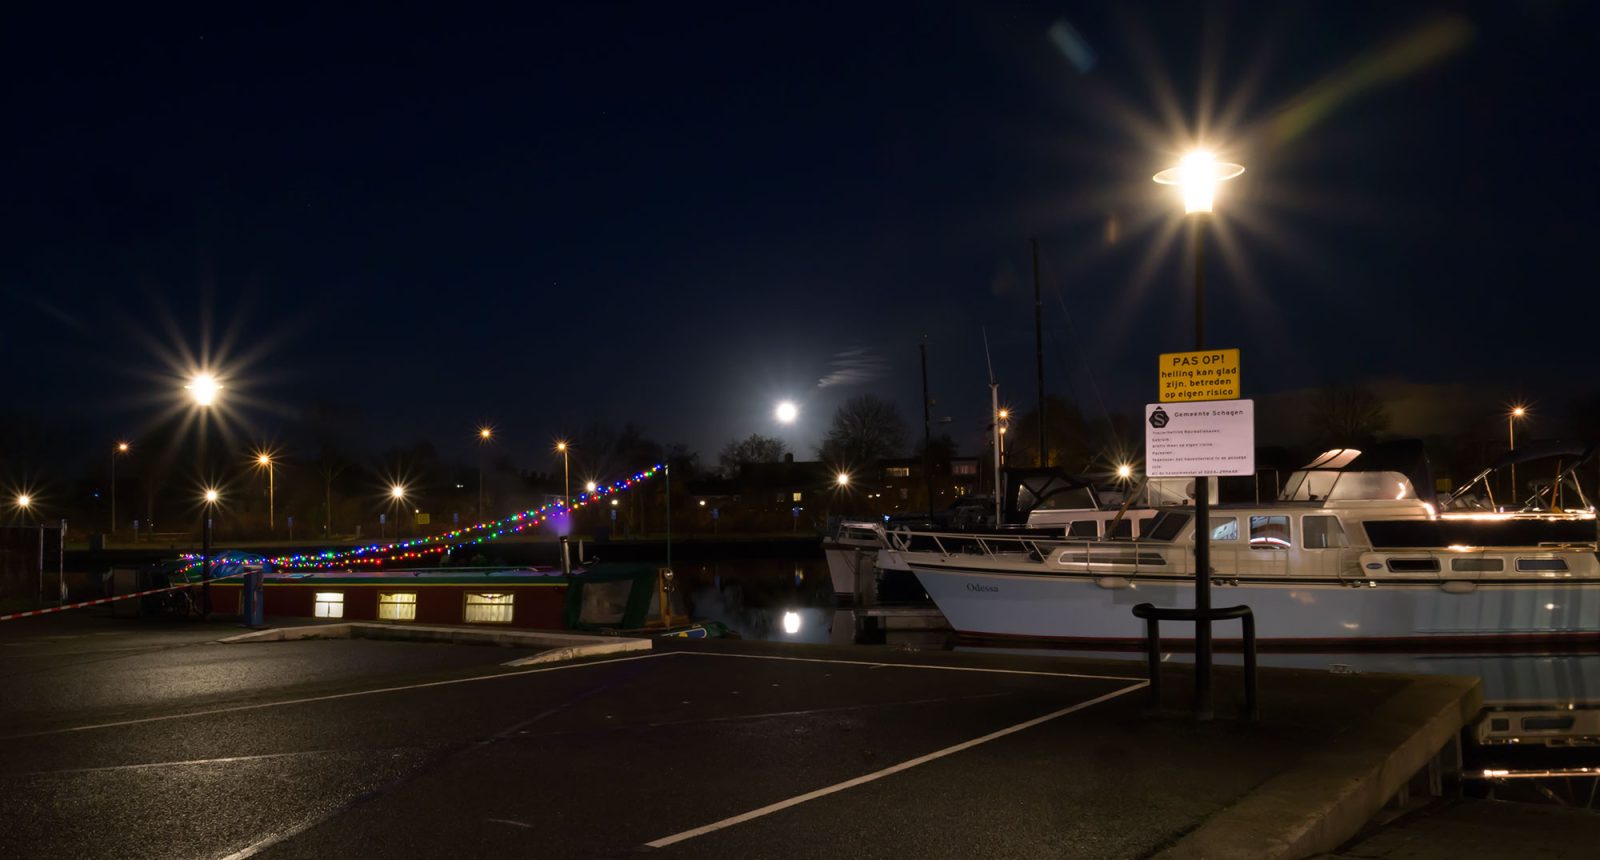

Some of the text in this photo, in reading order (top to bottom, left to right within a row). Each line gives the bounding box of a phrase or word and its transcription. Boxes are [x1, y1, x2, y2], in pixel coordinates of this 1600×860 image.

[1173, 354, 1224, 366] PAS OP!
[1216, 367, 1236, 377] glad
[1190, 378, 1231, 387] betreden
[1178, 389, 1203, 399] eigen
[1207, 388, 1233, 396] risico
[1174, 409, 1244, 418] Gemeente Schagen
[966, 583, 999, 592] Odessa
